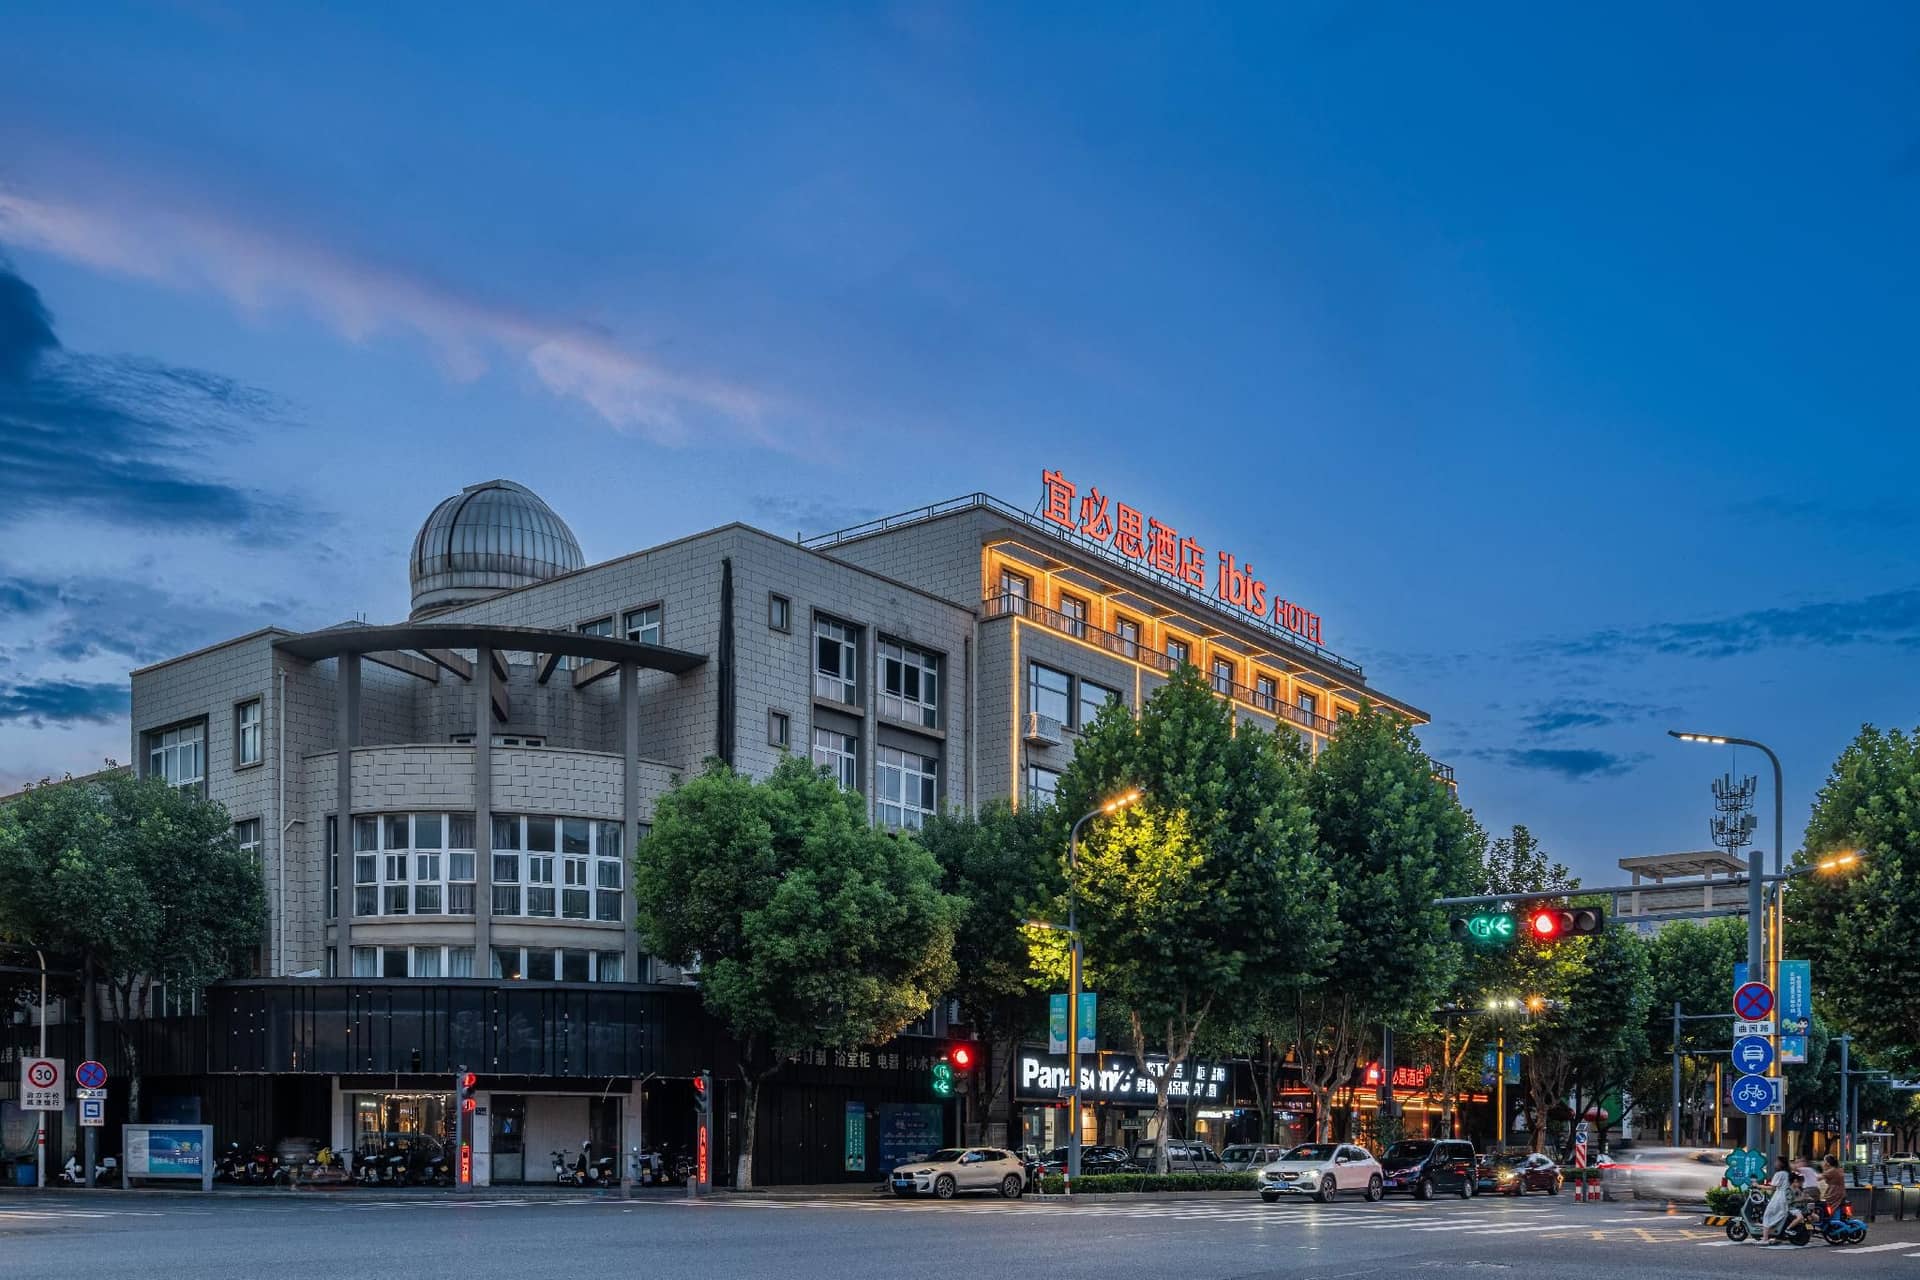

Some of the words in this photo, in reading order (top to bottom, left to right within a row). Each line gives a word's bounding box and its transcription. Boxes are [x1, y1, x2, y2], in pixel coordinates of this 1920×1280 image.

[1043, 469, 1205, 589] 宜必思酒店
[1218, 551, 1267, 616] ibis
[1274, 596, 1325, 646] HOTEL
[36, 1070, 52, 1081] 30
[834, 1048, 871, 1069] 浴室柜
[877, 1050, 900, 1070] 电器
